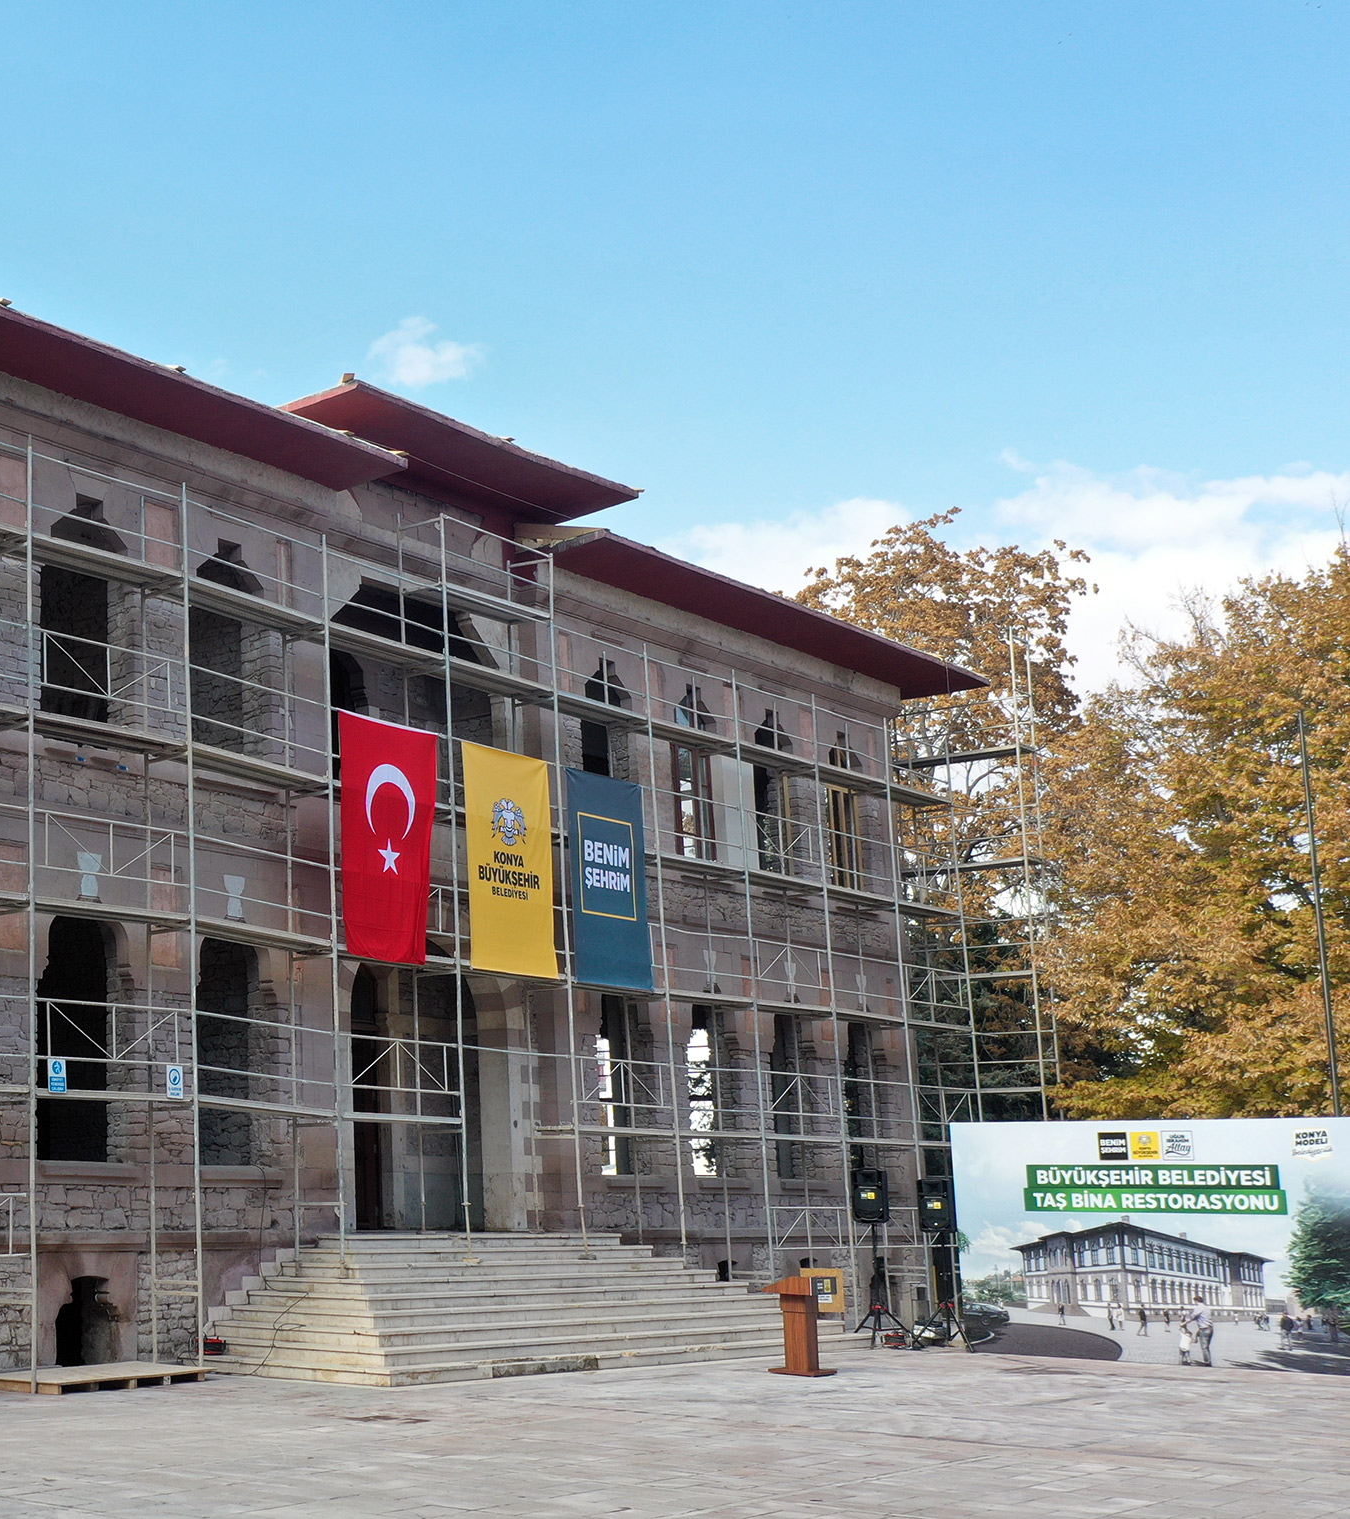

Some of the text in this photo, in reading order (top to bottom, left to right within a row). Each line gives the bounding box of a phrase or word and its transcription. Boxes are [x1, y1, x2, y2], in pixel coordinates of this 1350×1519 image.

[493, 850, 524, 868] KONYA
[478, 862, 540, 890] BÜYÜKŞEHİR
[491, 886, 529, 901] BELEDİYESİ
[1295, 1130, 1328, 1140] KONYA
[1036, 1166, 1272, 1188] BÜYÜKŞEHİR BELEDİYESİ
[1032, 1190, 1279, 1211] TAŞ BİNA RESTORASYONU
